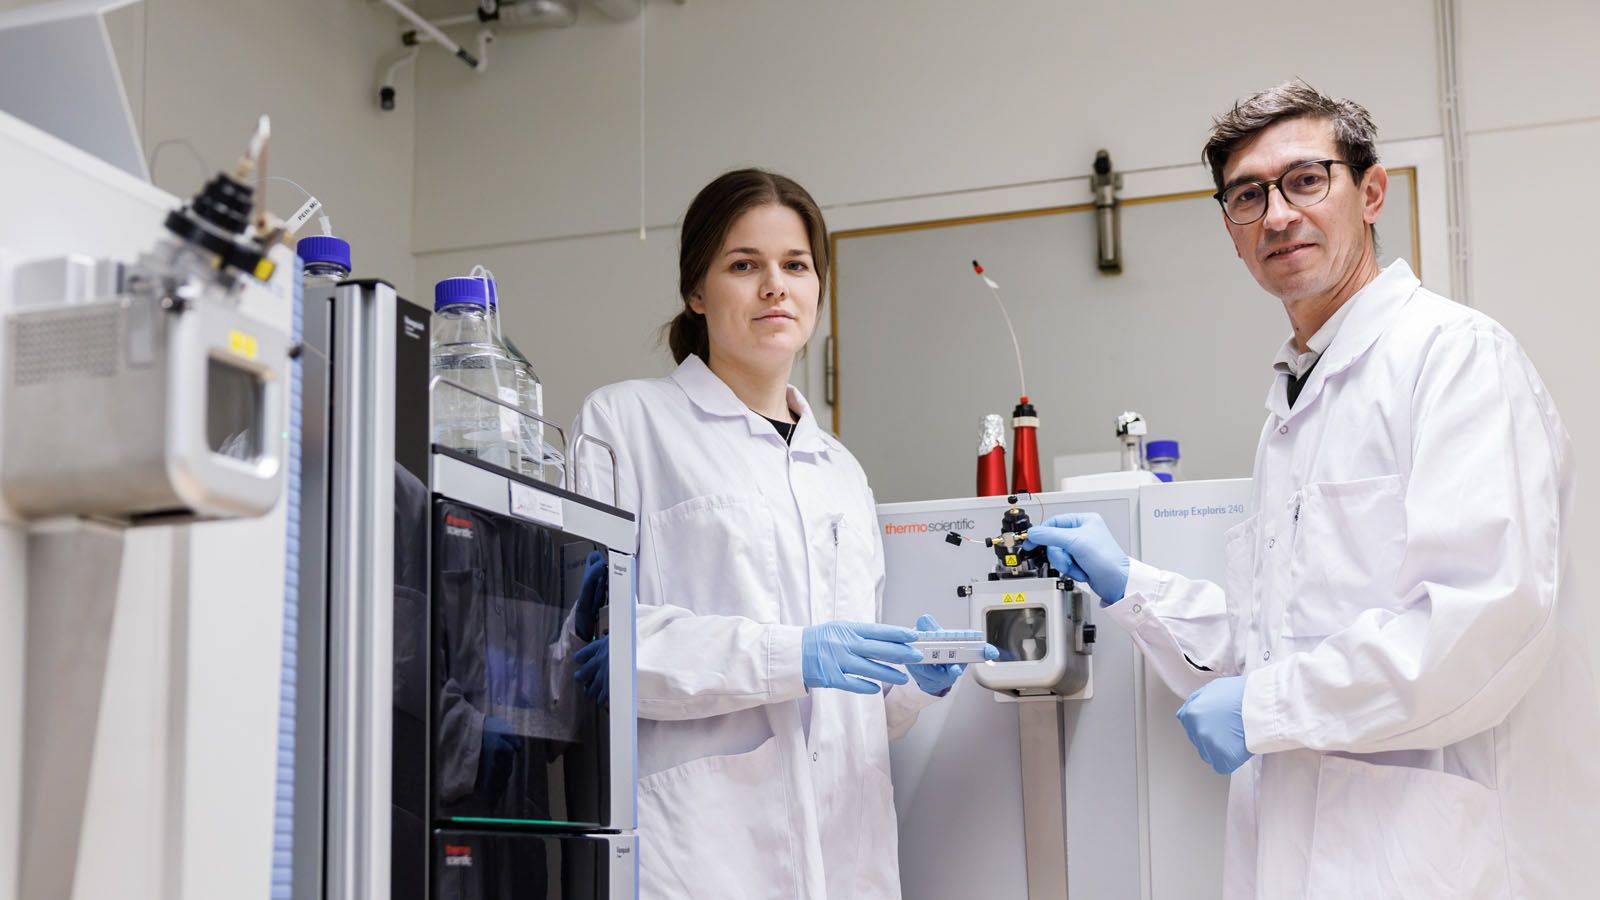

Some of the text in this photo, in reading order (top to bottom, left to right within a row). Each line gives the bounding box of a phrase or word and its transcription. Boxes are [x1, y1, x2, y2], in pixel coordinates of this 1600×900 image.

[1154, 504, 1244, 518] Orbitrap Exploris 240
[885, 518, 975, 535] thermo scientific
